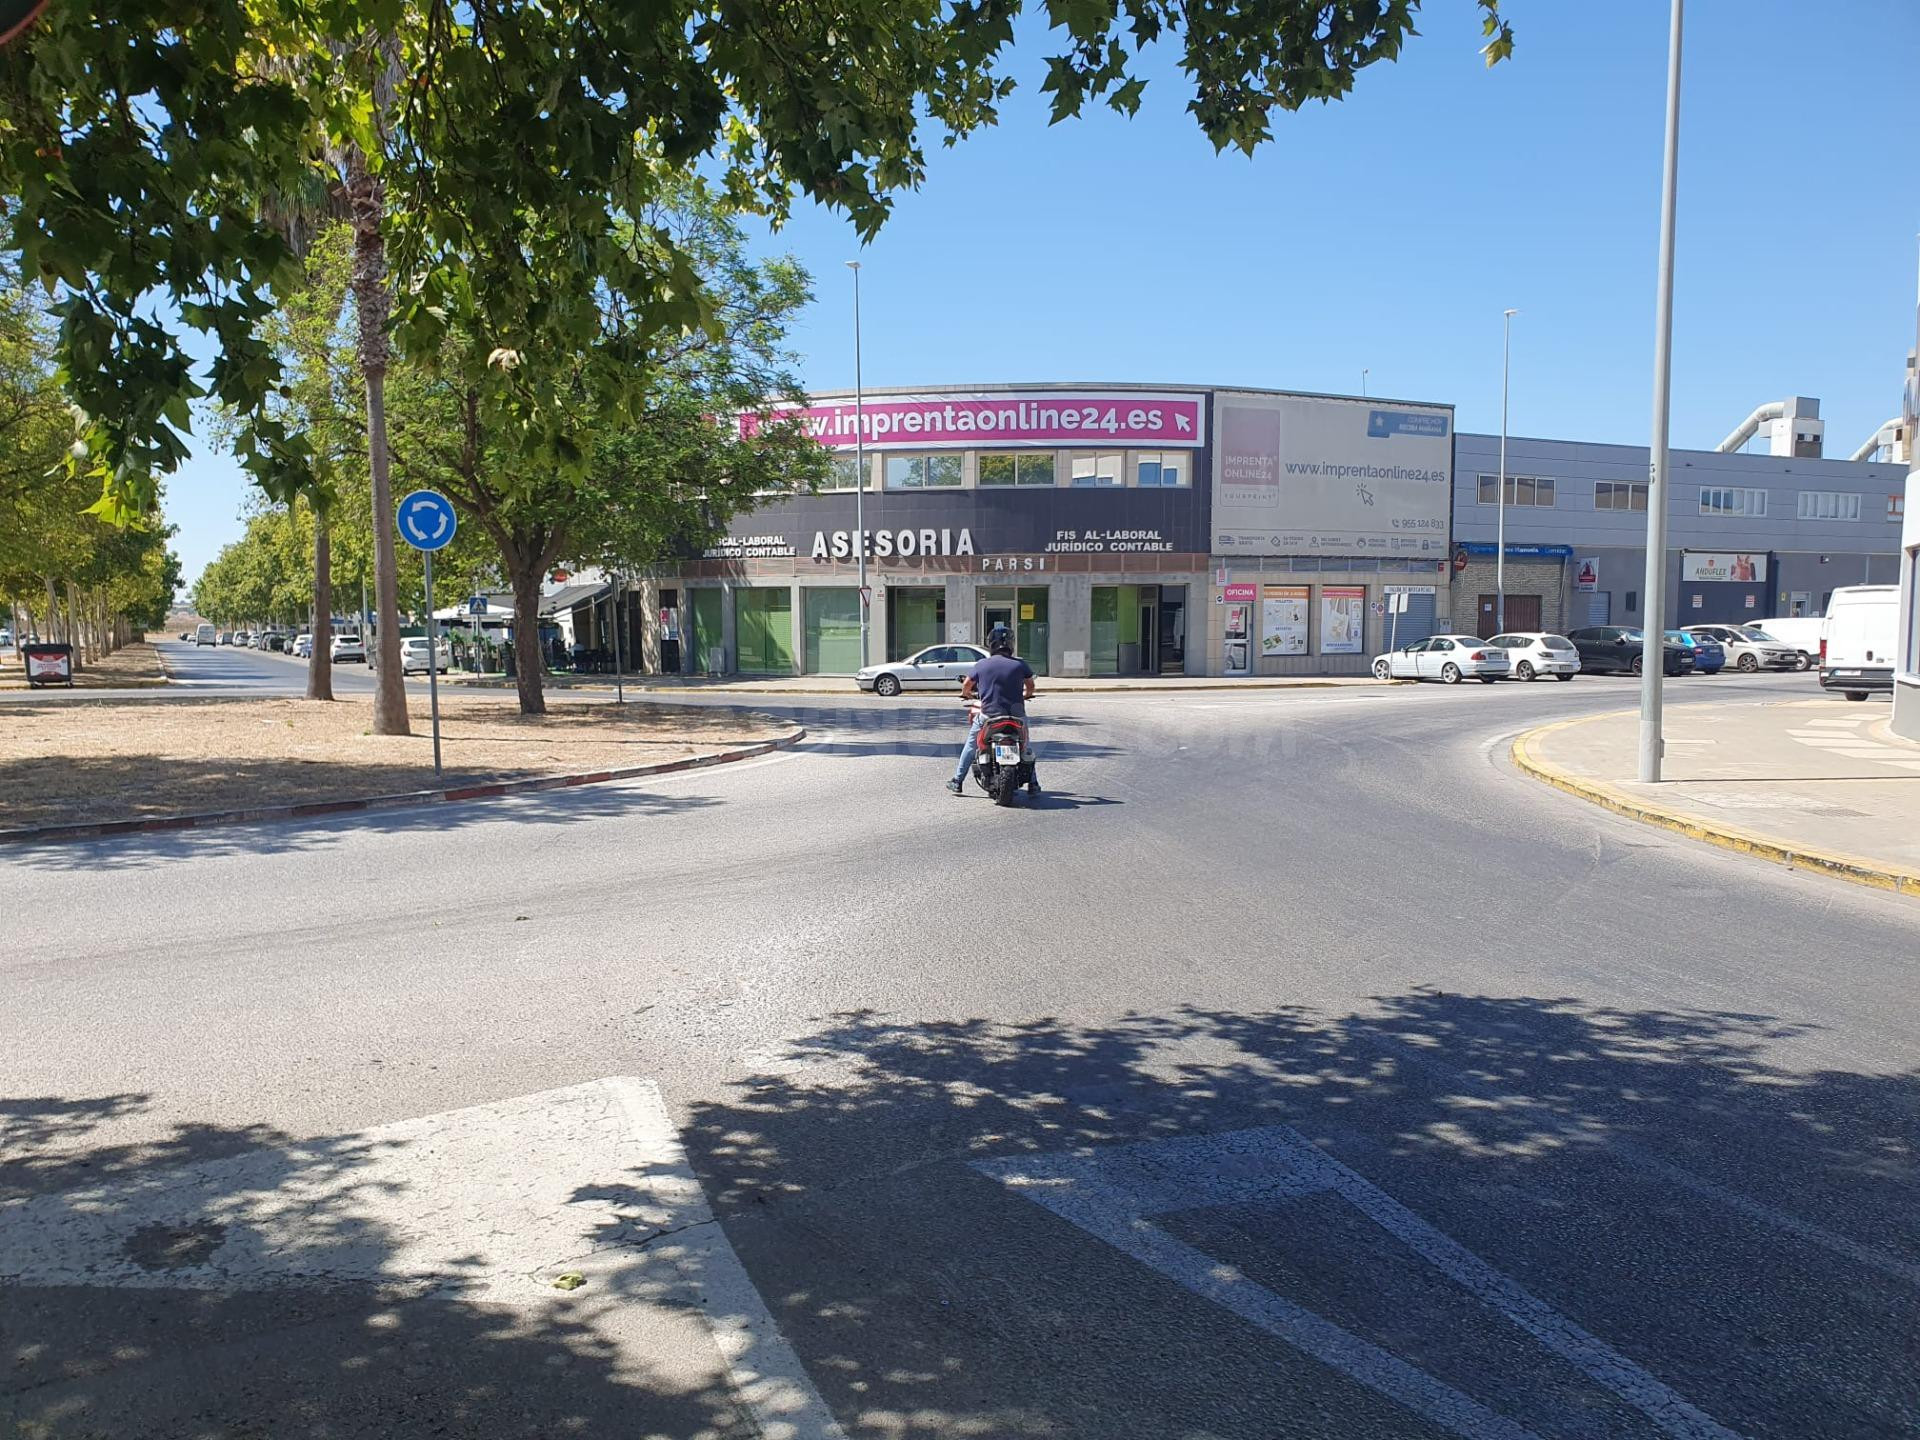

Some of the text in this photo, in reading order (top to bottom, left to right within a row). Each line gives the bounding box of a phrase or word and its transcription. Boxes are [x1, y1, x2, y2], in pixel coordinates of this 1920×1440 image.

[758, 403, 1163, 441] w.imprentaonline24.es
[1225, 455, 1273, 467] IMPRENTA
[1224, 469, 1272, 480] ONLINE24
[1285, 461, 1445, 482] www.imprentaonline24.es
[1402, 519, 1416, 529] 955
[1417, 519, 1429, 529] 124
[707, 535, 786, 547] SCAL-LABORAL
[811, 528, 975, 558] ASESORIA
[1045, 541, 1174, 552] JURÍDICO CONTABLE
[703, 546, 796, 558] JURÍDICO CONTABLE
[982, 557, 1045, 571] PARSI
[1226, 588, 1254, 596] OFICINA
